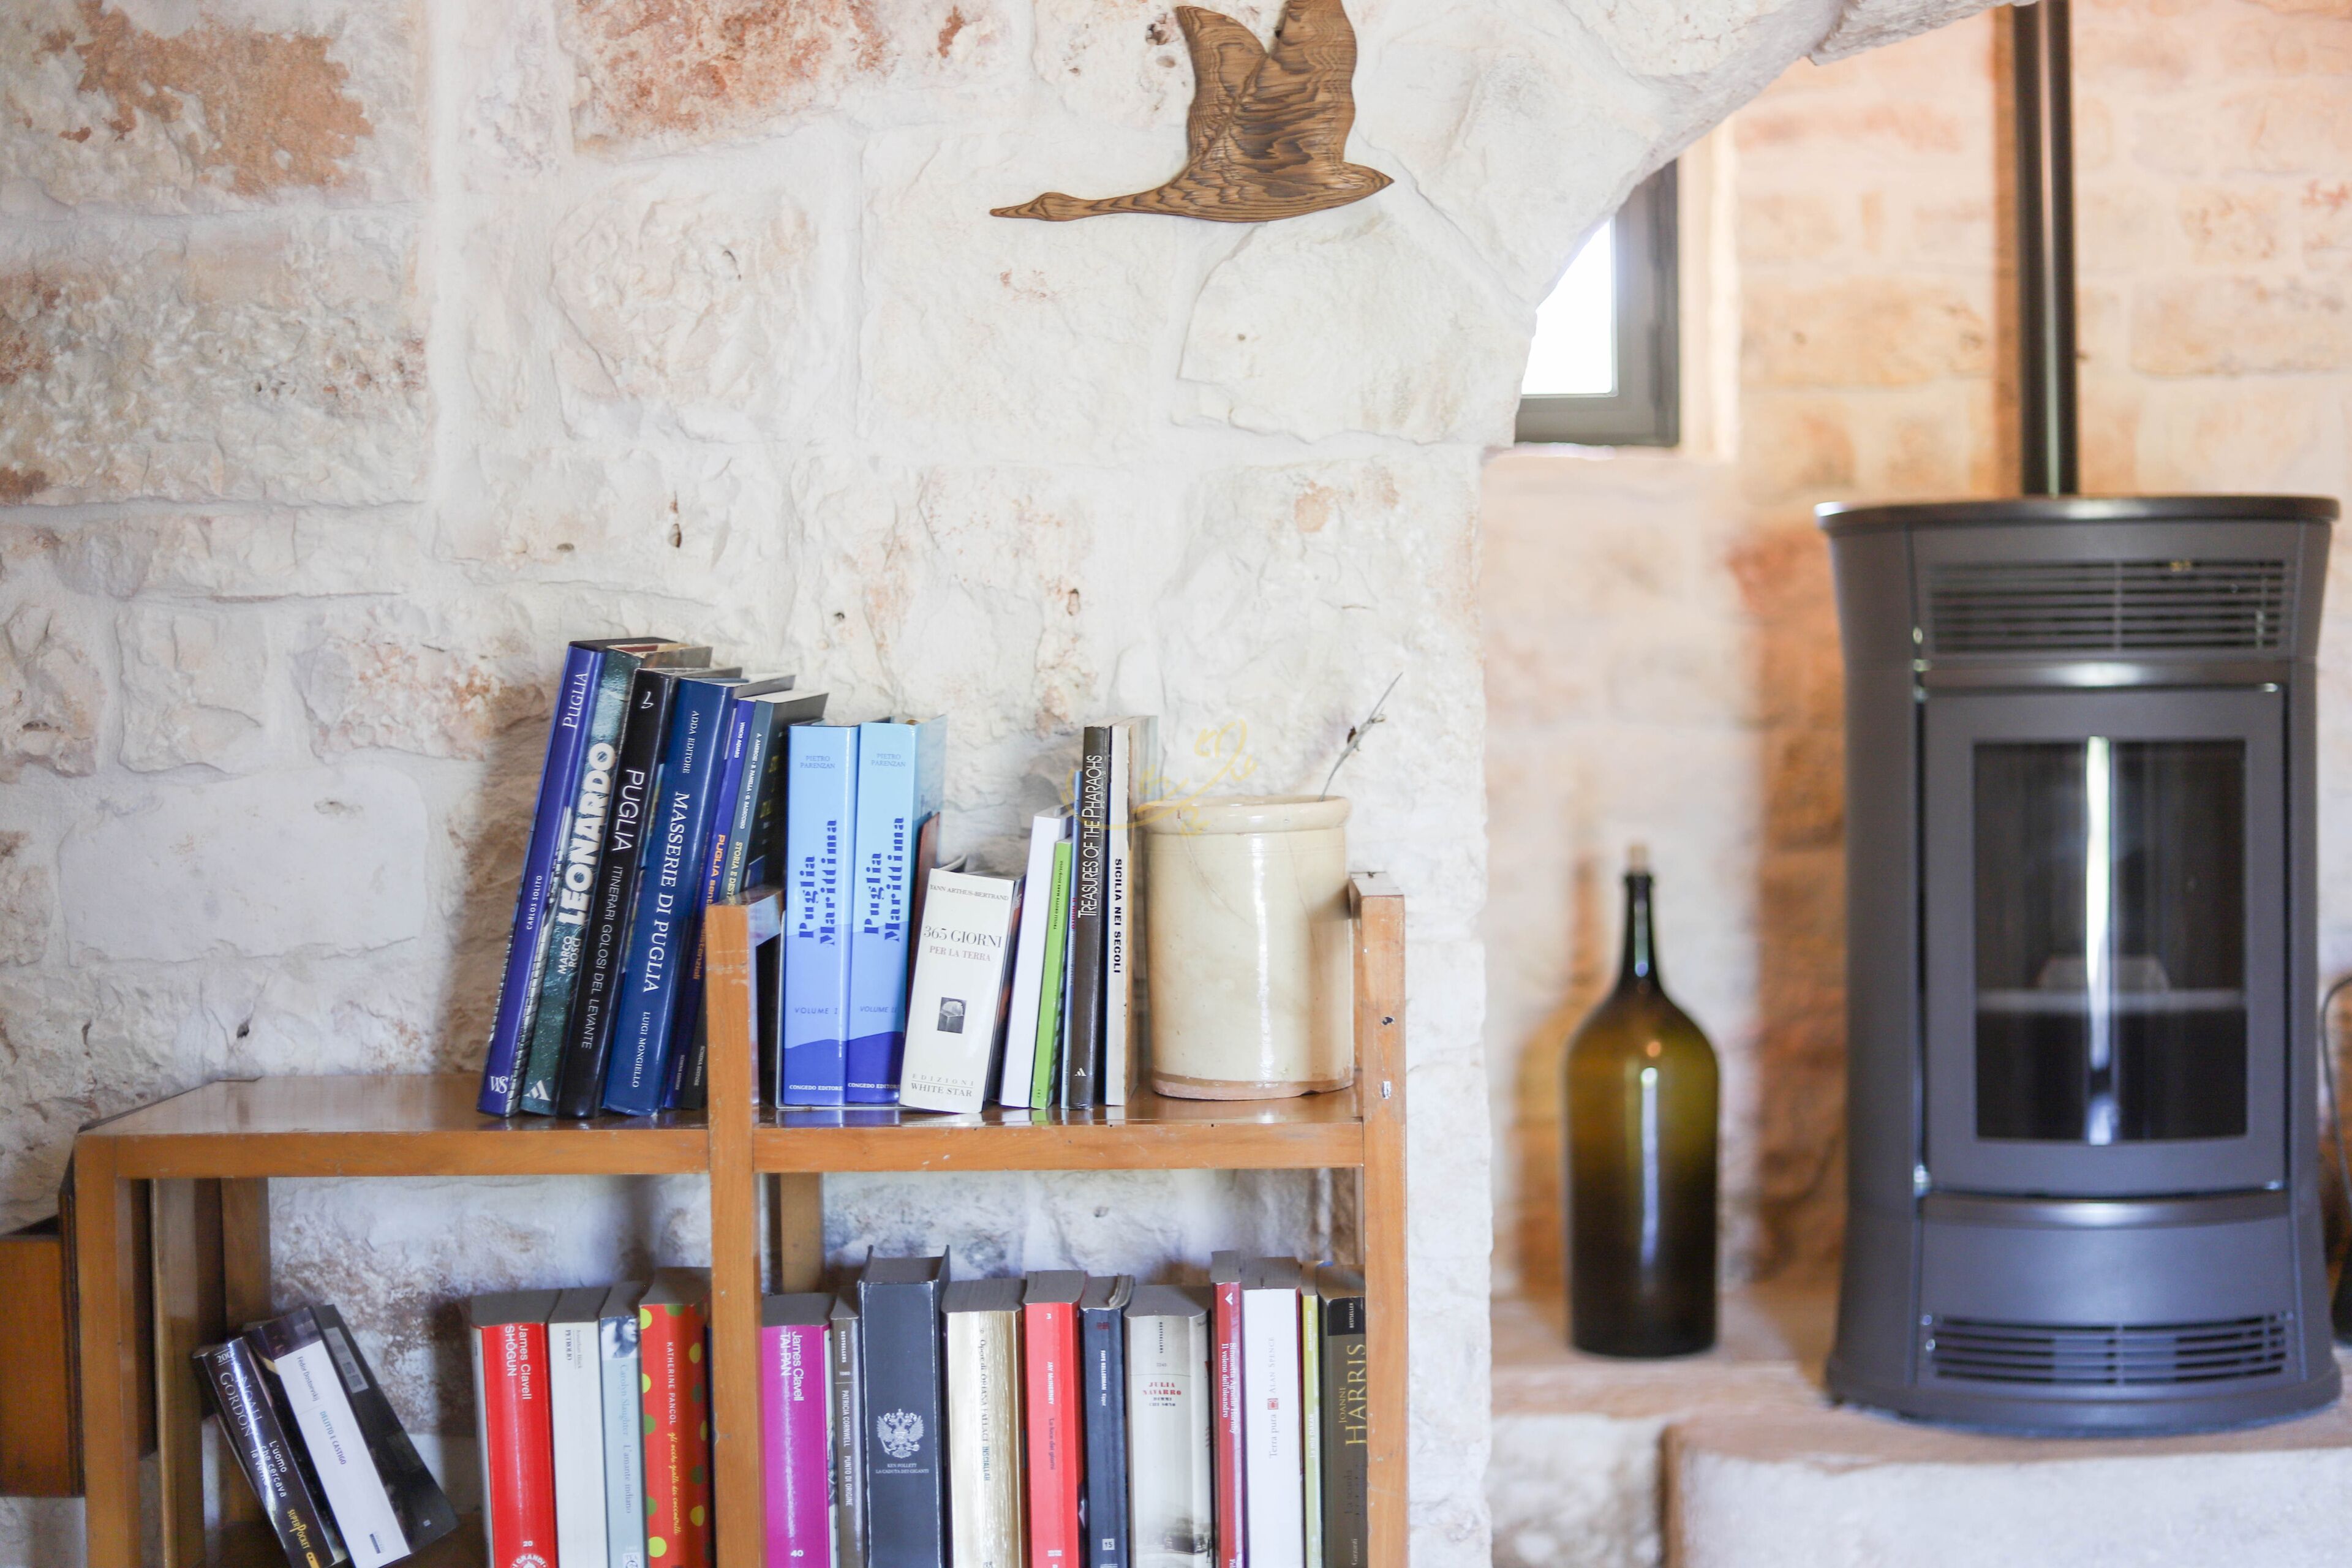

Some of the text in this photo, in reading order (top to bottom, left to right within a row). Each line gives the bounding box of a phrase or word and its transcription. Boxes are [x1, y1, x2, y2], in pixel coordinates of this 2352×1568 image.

[562, 673, 589, 729] PUGLIA
[682, 710, 699, 774] ADDA EDITORE
[557, 742, 616, 925] LEONARDO
[711, 834, 726, 877] PUGLIA
[731, 842, 743, 870] STORIA
[1078, 755, 1102, 918] TREASURES OF THE PHARAOHS
[526, 875, 543, 930] CARLOS SOLITO
[643, 791, 690, 993] MASSERIE DI PUGLIA
[799, 856, 819, 938] Puglia
[820, 820, 837, 945] Marittima
[864, 853, 884, 935] Puglia
[884, 817, 904, 942] Marittima
[947, 888, 1009, 901] ARTHUS-BERTRAND
[582, 769, 645, 1049] PUGLIA ITINERARI GOLOSI DEL LEVANTE
[557, 936, 572, 974] MARCO
[568, 938, 581, 968] ROSCI
[924, 925, 1002, 948] 365 GIORNI
[929, 945, 991, 962] PER LA TERRA
[632, 1012, 650, 1088] LUIGI MONGIELLO
[911, 1083, 973, 1097] WHITE STAR
[519, 1325, 532, 1400] James Clavell
[666, 1342, 675, 1389] KATHERINE
[780, 1332, 792, 1376] TAI-PAN
[792, 1331, 804, 1401] James Clavell
[220, 1372, 253, 1437] GORDON
[618, 1364, 627, 1400] Carolyn
[842, 1390, 850, 1417] PATRICIA
[1338, 1387, 1347, 1423] JOANNE
[1345, 1344, 1367, 1446] HARRIS
[250, 1449, 258, 1459] la
[269, 1440, 287, 1473] L'uomo
[319, 1411, 334, 1436] DELITTO
[332, 1440, 347, 1465] CASTIGO
[269, 1463, 287, 1498] cercava
